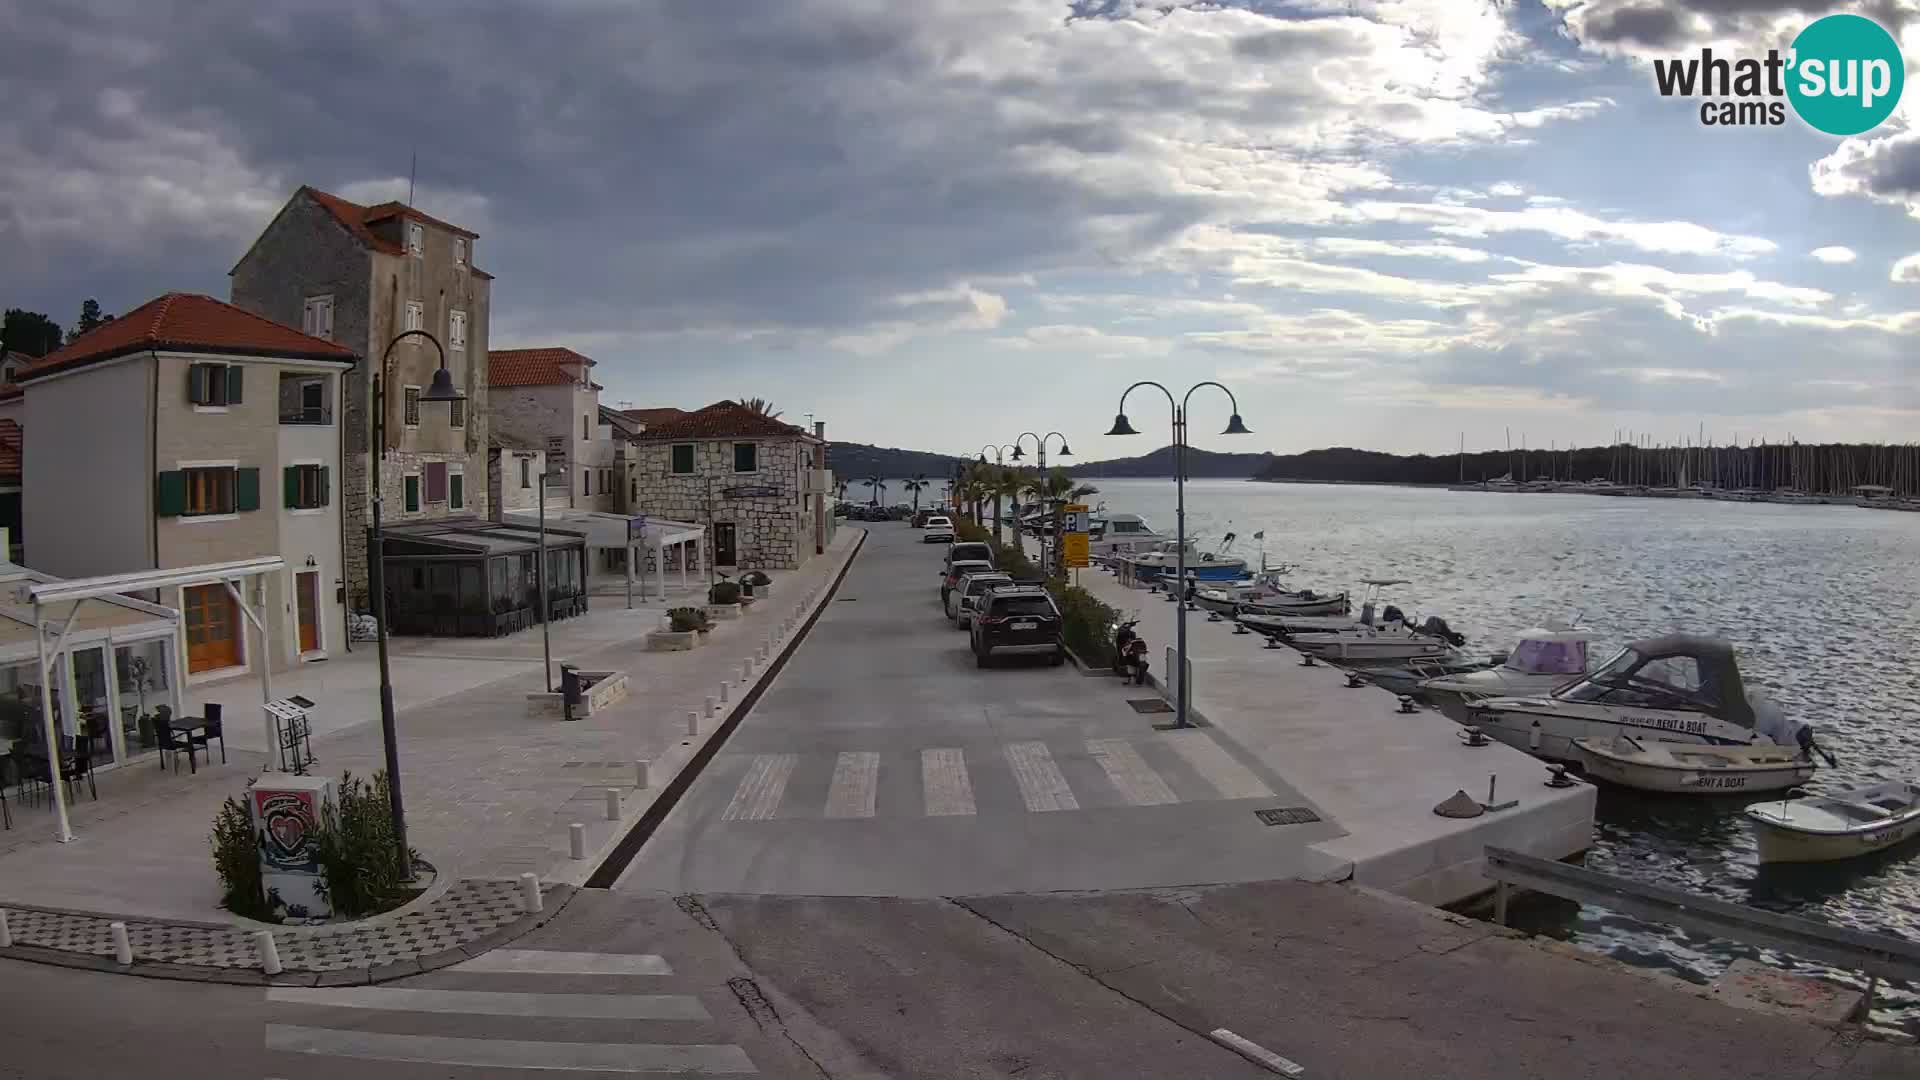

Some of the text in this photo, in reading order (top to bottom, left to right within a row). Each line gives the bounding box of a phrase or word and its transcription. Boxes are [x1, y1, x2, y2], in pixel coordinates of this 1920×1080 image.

[1656, 718, 1678, 730] RENT
[1679, 719, 1685, 730] A
[1686, 720, 1708, 734] BOAT
[1716, 777, 1723, 788] A
[1724, 777, 1745, 788] BOAT
